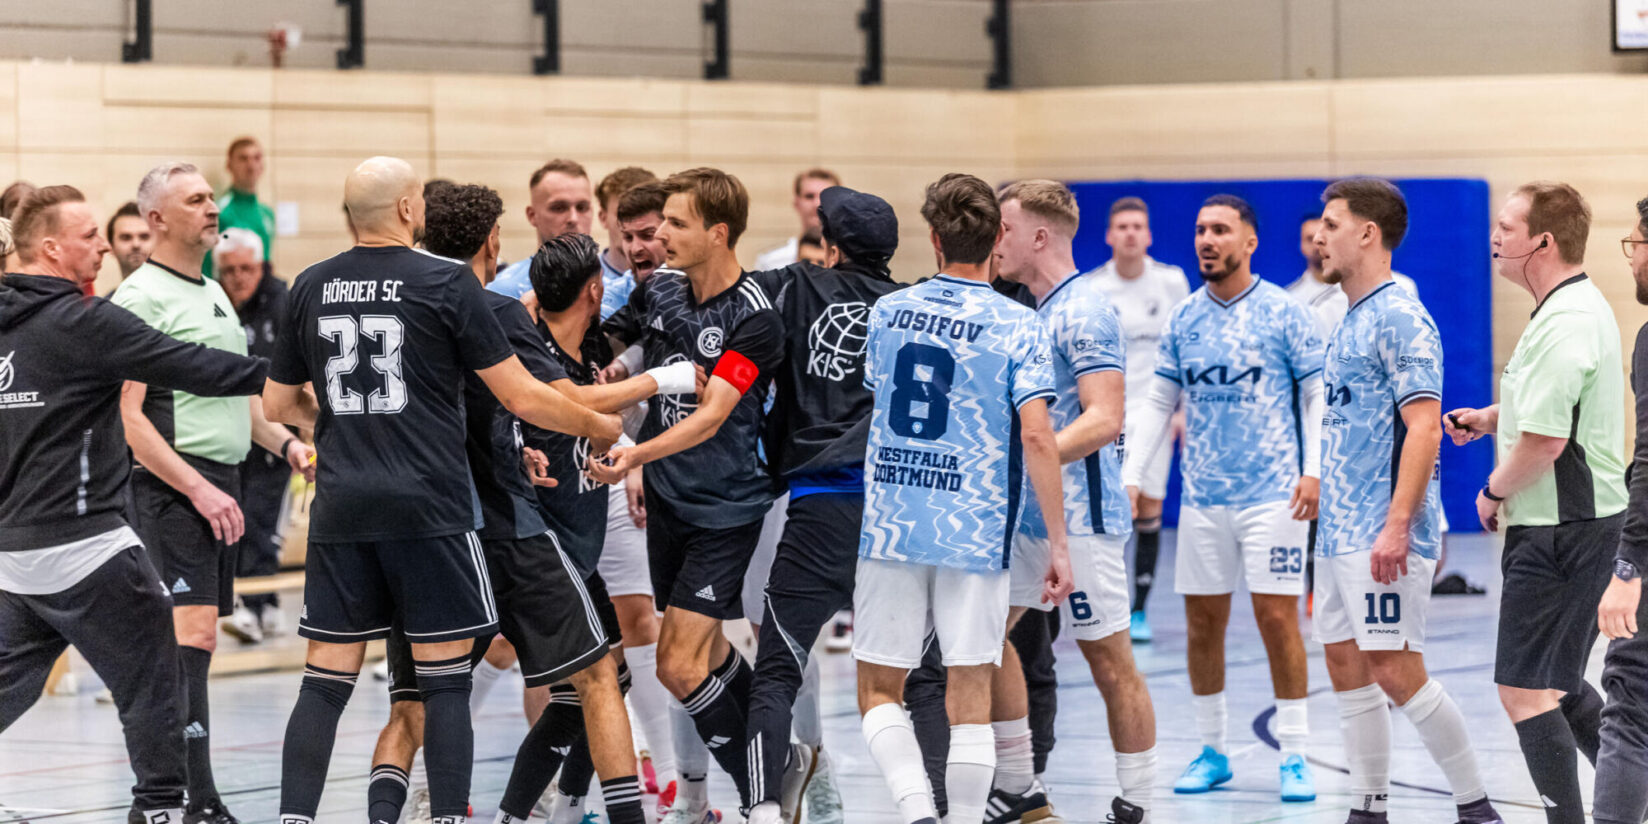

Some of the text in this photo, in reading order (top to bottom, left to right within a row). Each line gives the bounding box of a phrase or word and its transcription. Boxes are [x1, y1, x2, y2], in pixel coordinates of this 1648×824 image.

[322, 278, 404, 304] HÖRDER SC
[887, 309, 985, 343] JOSIFOV
[318, 314, 408, 416] 23
[888, 341, 956, 441] 8
[877, 446, 959, 471] WESTFALIA
[873, 463, 962, 492] DORTMUND
[1270, 546, 1302, 573] 23
[1068, 590, 1093, 620] 6
[1365, 592, 1401, 624] 10
